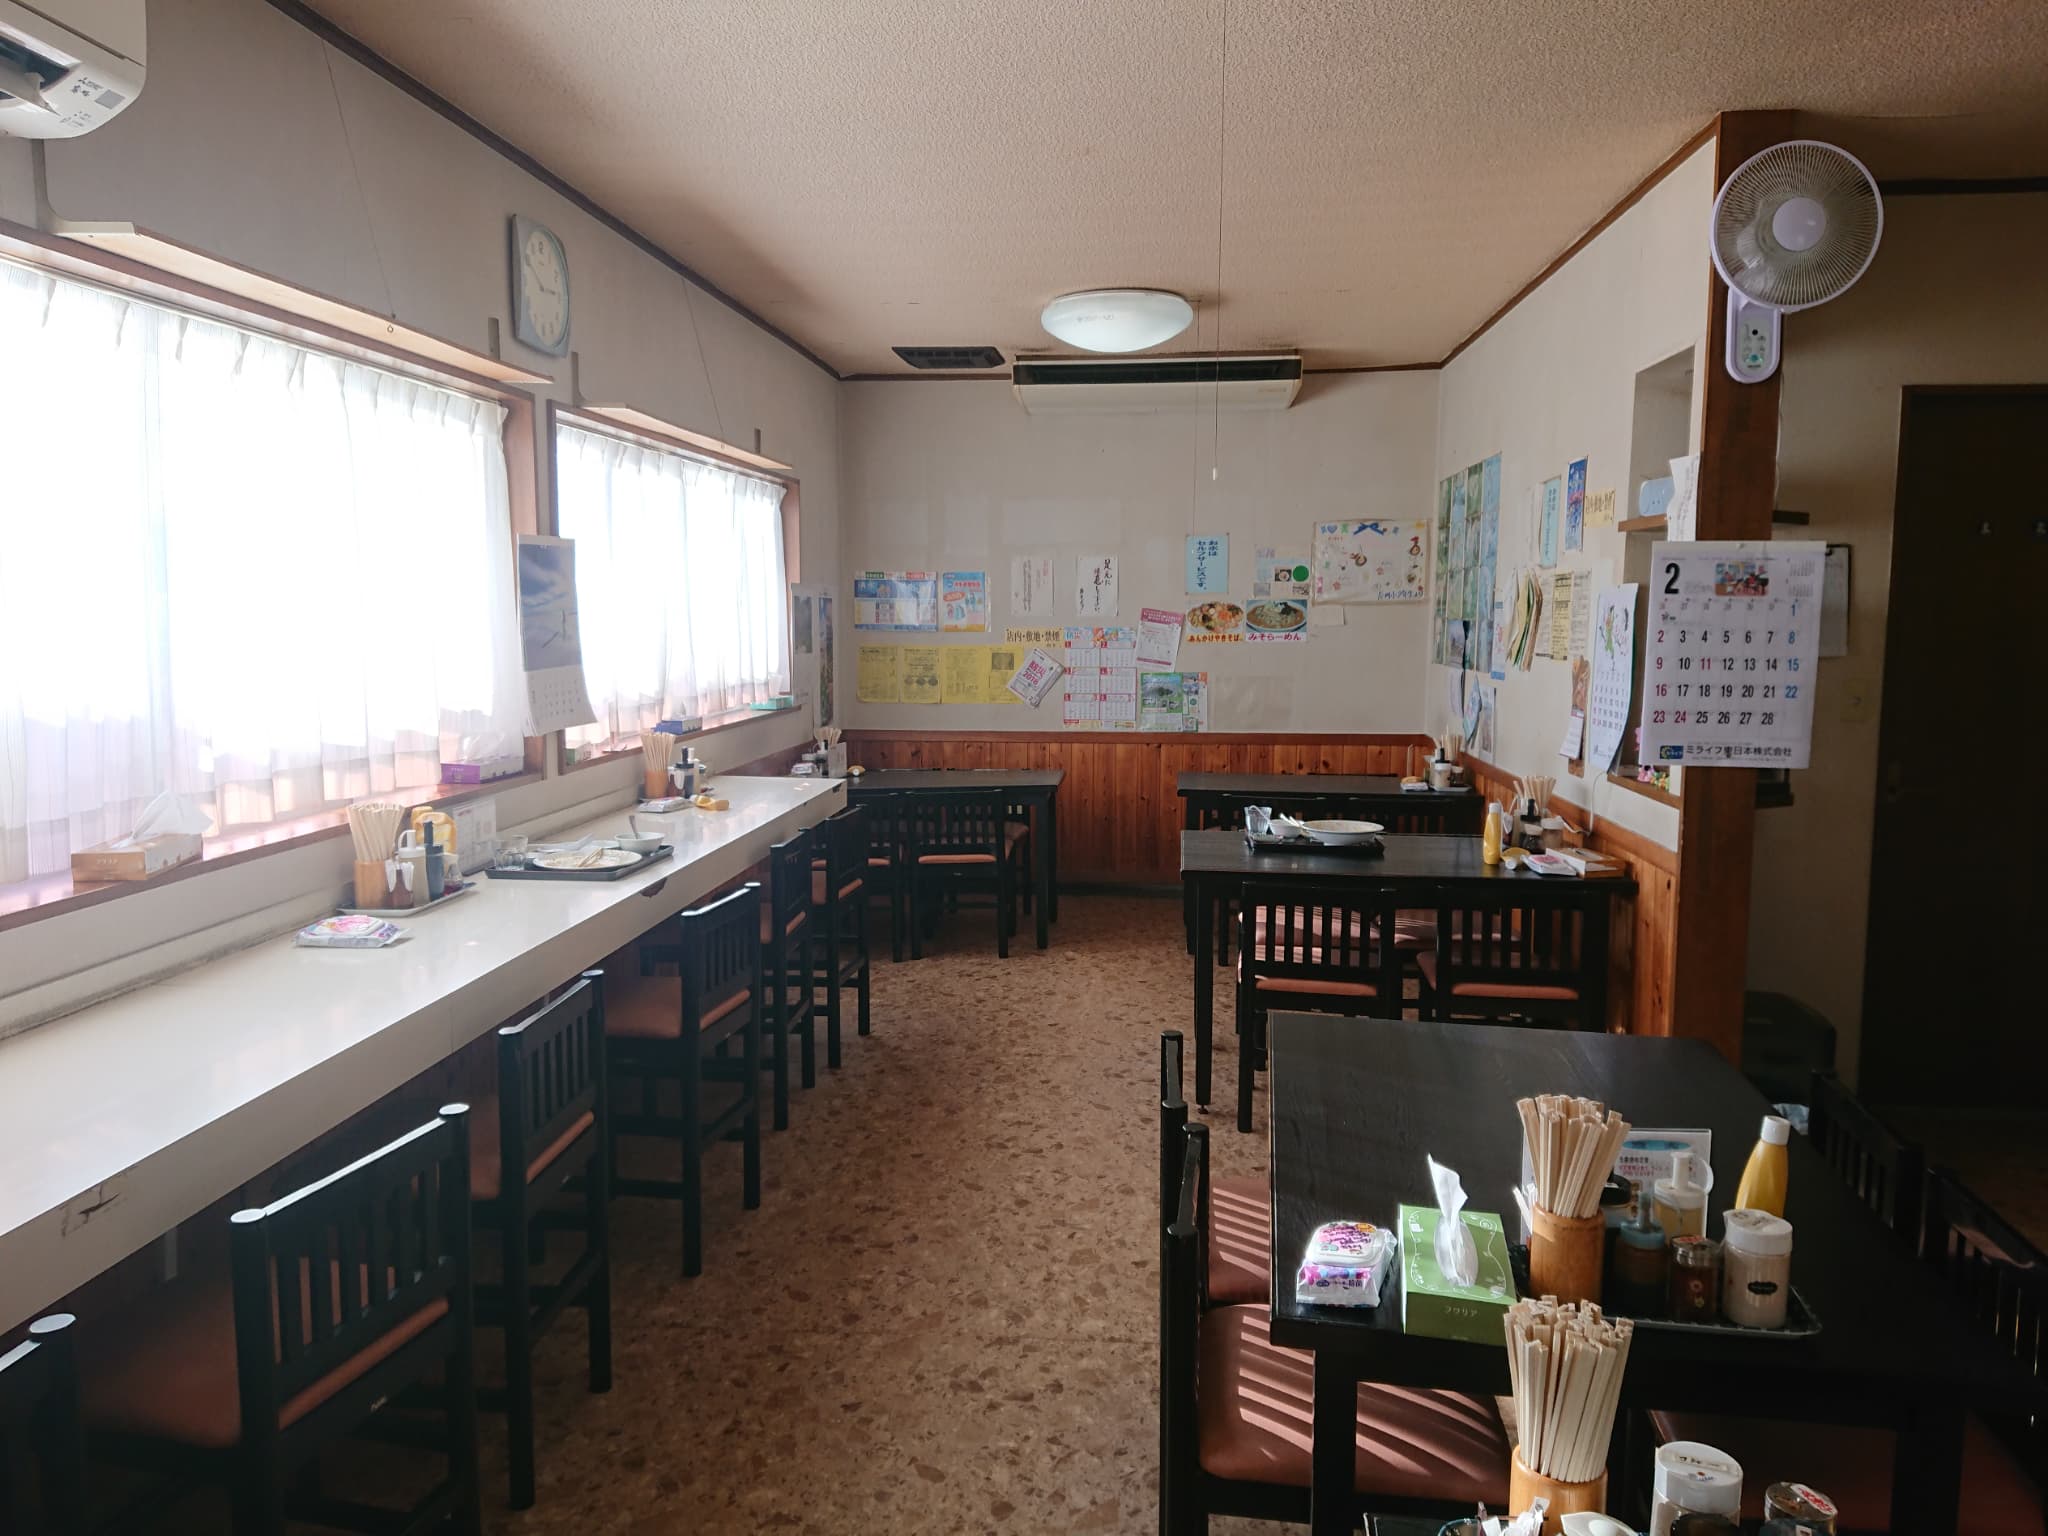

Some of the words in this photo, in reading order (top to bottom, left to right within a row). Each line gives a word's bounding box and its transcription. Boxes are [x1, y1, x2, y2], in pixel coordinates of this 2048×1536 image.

[1664, 562, 1680, 595] 2
[1790, 604, 1797, 617] 1
[1189, 633, 1240, 642] あんかけやきそば
[1248, 632, 1302, 641] みそらーめん
[1657, 629, 1665, 643] 2
[1679, 629, 1687, 644] 3
[1701, 630, 1708, 643] 4
[1723, 630, 1730, 644] 5
[1744, 630, 1752, 644] 6
[1767, 630, 1775, 644] 7
[1787, 630, 1796, 645] 8
[1656, 656, 1664, 670] 9
[1679, 656, 1691, 671] 10
[1700, 657, 1711, 671] 11
[1722, 657, 1735, 671] 12
[1744, 657, 1756, 671] 13
[1765, 657, 1778, 671] 14
[1787, 657, 1800, 672] 15
[1655, 683, 1668, 697] 16
[1677, 683, 1690, 697] 17
[1699, 684, 1711, 698] 18
[1721, 684, 1733, 698] 19
[1741, 684, 1755, 698] 20
[1763, 684, 1776, 699] 21
[1784, 685, 1799, 699] 22
[1652, 710, 1666, 724] 23
[1674, 710, 1687, 724] 24
[1695, 710, 1709, 724] 25
[1717, 711, 1731, 725] 26
[1739, 711, 1753, 725] 27
[1760, 711, 1774, 726] 28
